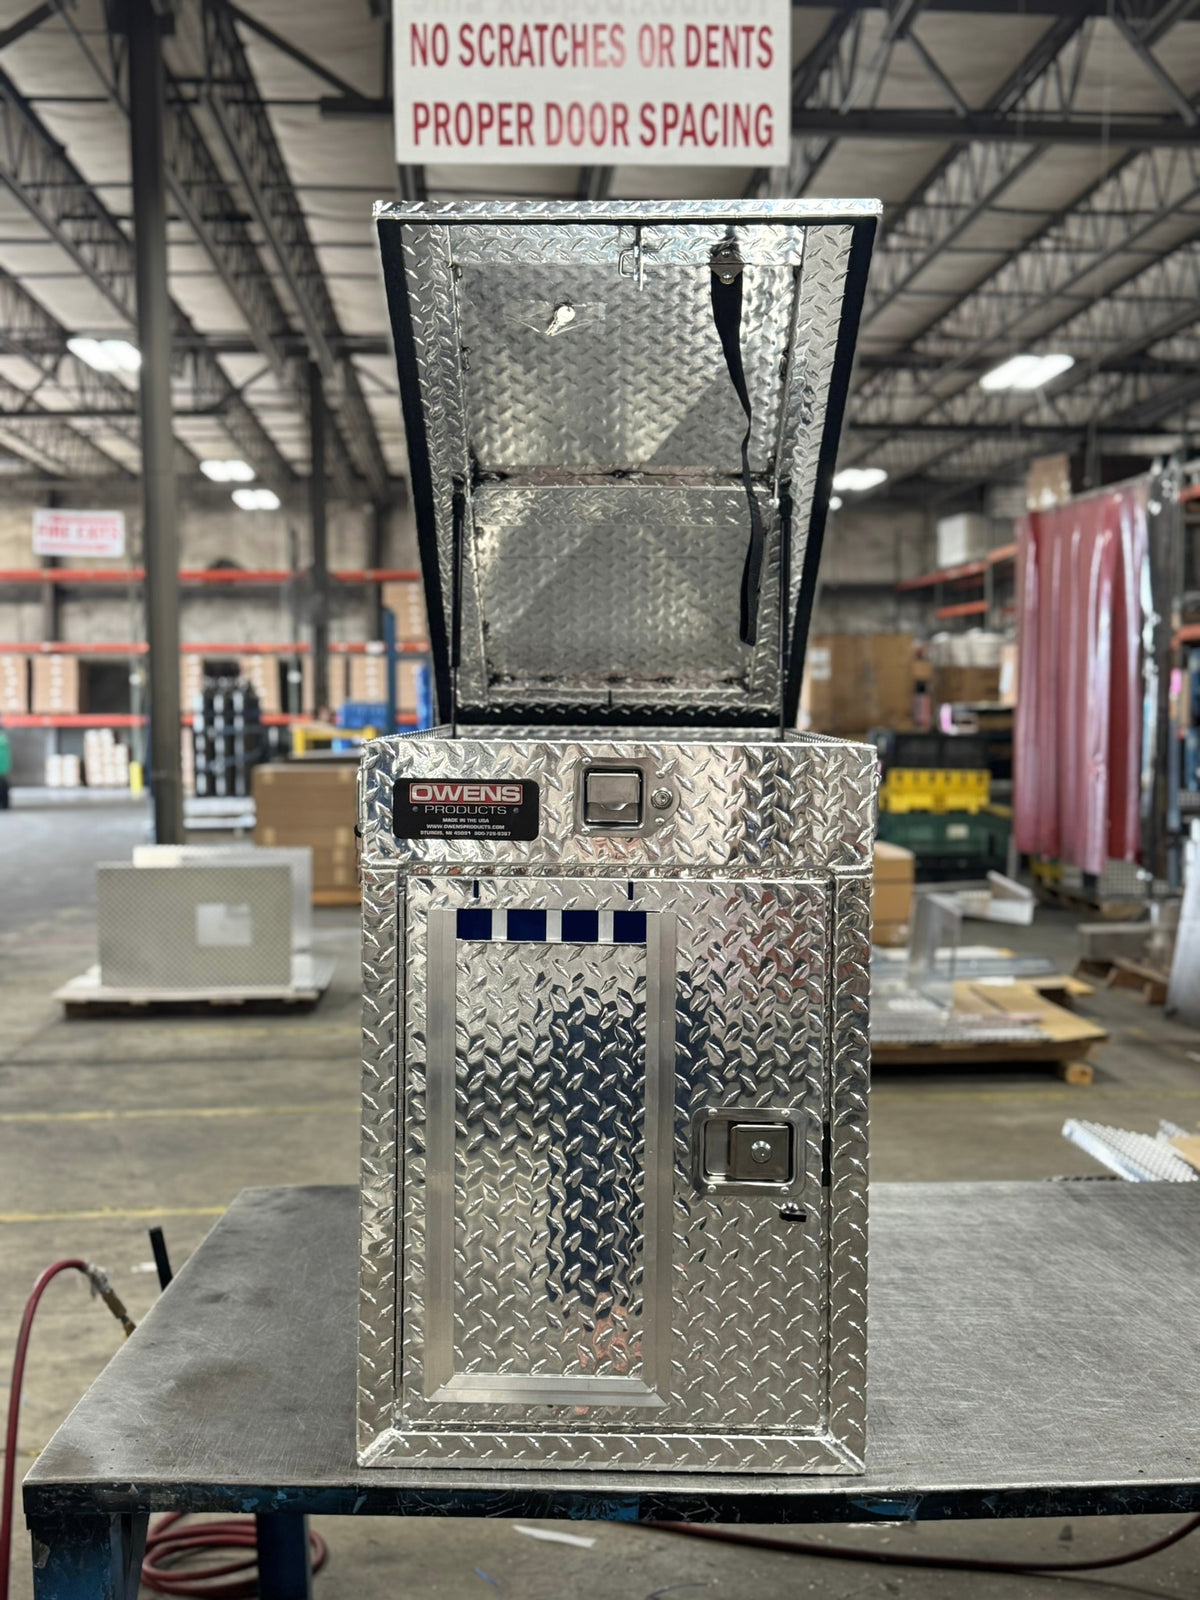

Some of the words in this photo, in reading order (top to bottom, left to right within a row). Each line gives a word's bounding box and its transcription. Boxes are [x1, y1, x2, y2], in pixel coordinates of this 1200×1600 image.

[410, 22, 449, 68] NO
[458, 23, 627, 68] SCRATCHES
[637, 24, 676, 68] OR
[685, 25, 774, 69] DENTS
[413, 102, 535, 147] PROPER
[544, 102, 630, 147] DOOR
[639, 103, 774, 148] SPACING
[411, 785, 521, 803] OWENS
[424, 805, 507, 815] PRODUCTS
